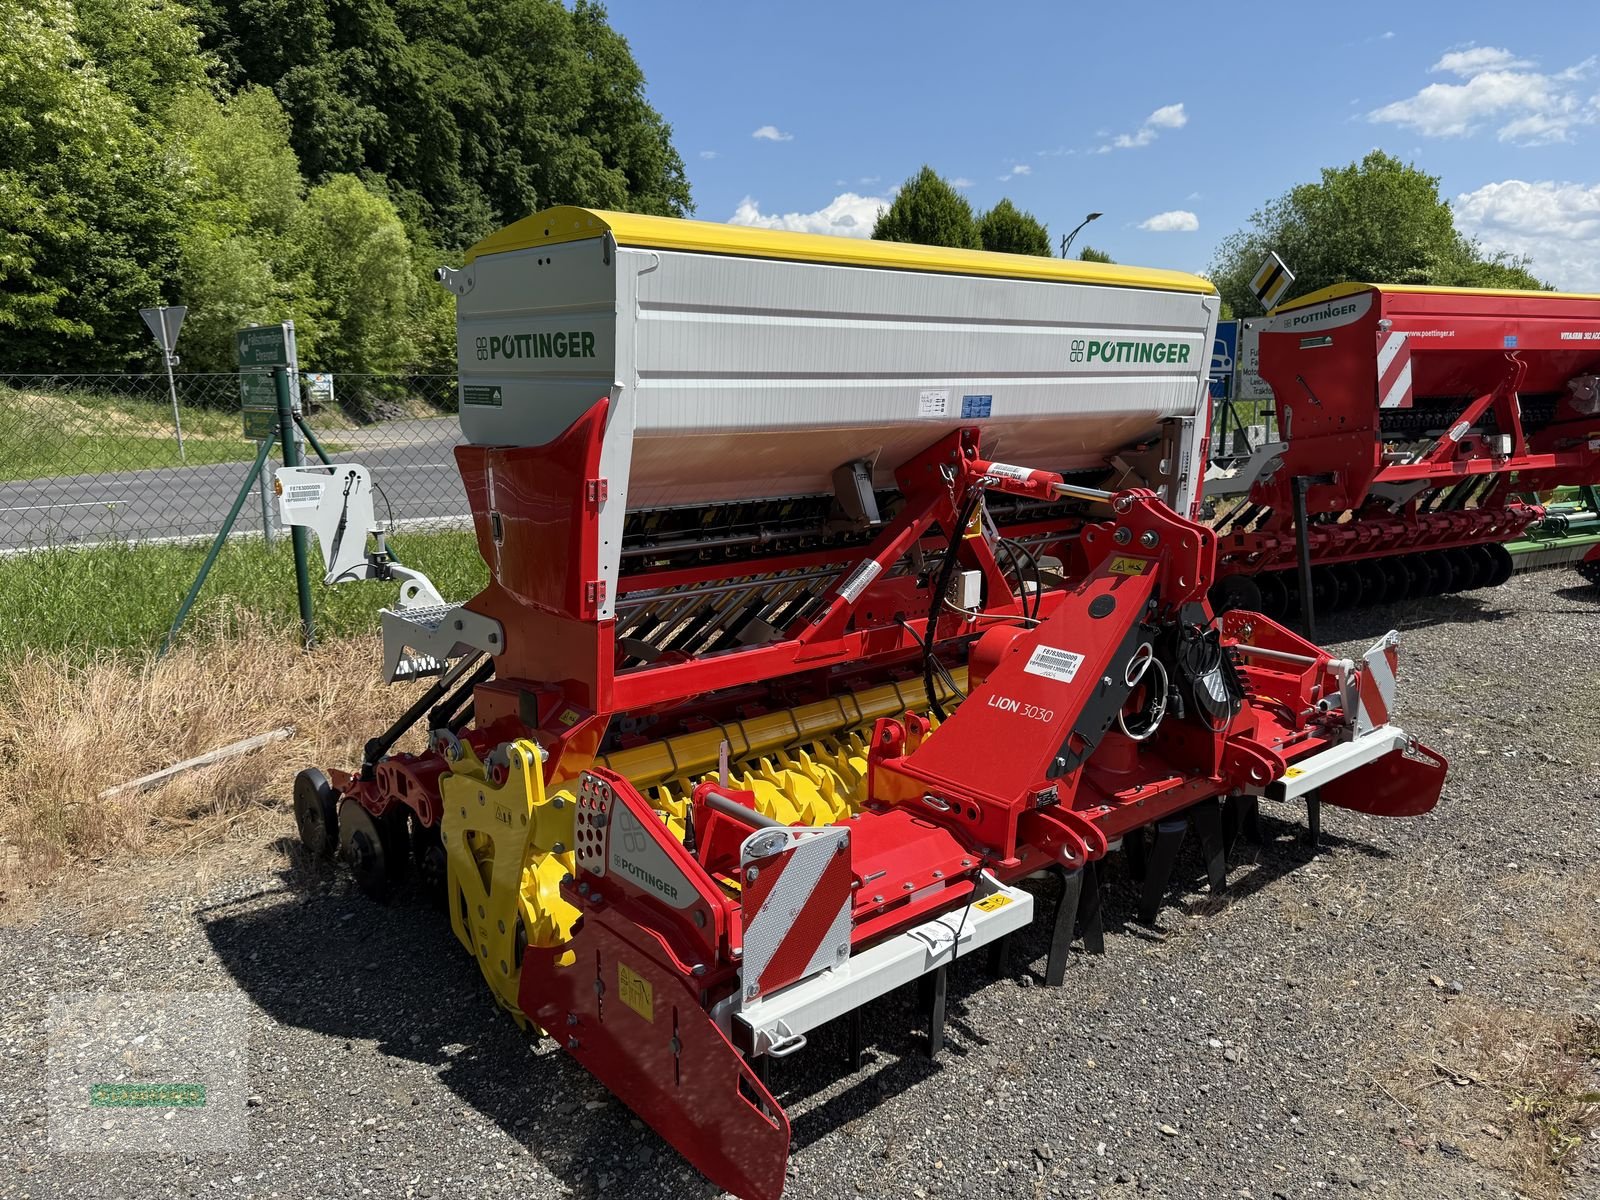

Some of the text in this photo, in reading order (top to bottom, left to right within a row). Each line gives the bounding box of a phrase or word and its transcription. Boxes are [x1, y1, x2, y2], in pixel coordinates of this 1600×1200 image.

[489, 331, 596, 359] PÖTTINGER
[1086, 340, 1191, 364] PÖTTINGER
[988, 694, 1054, 723] LION 3030
